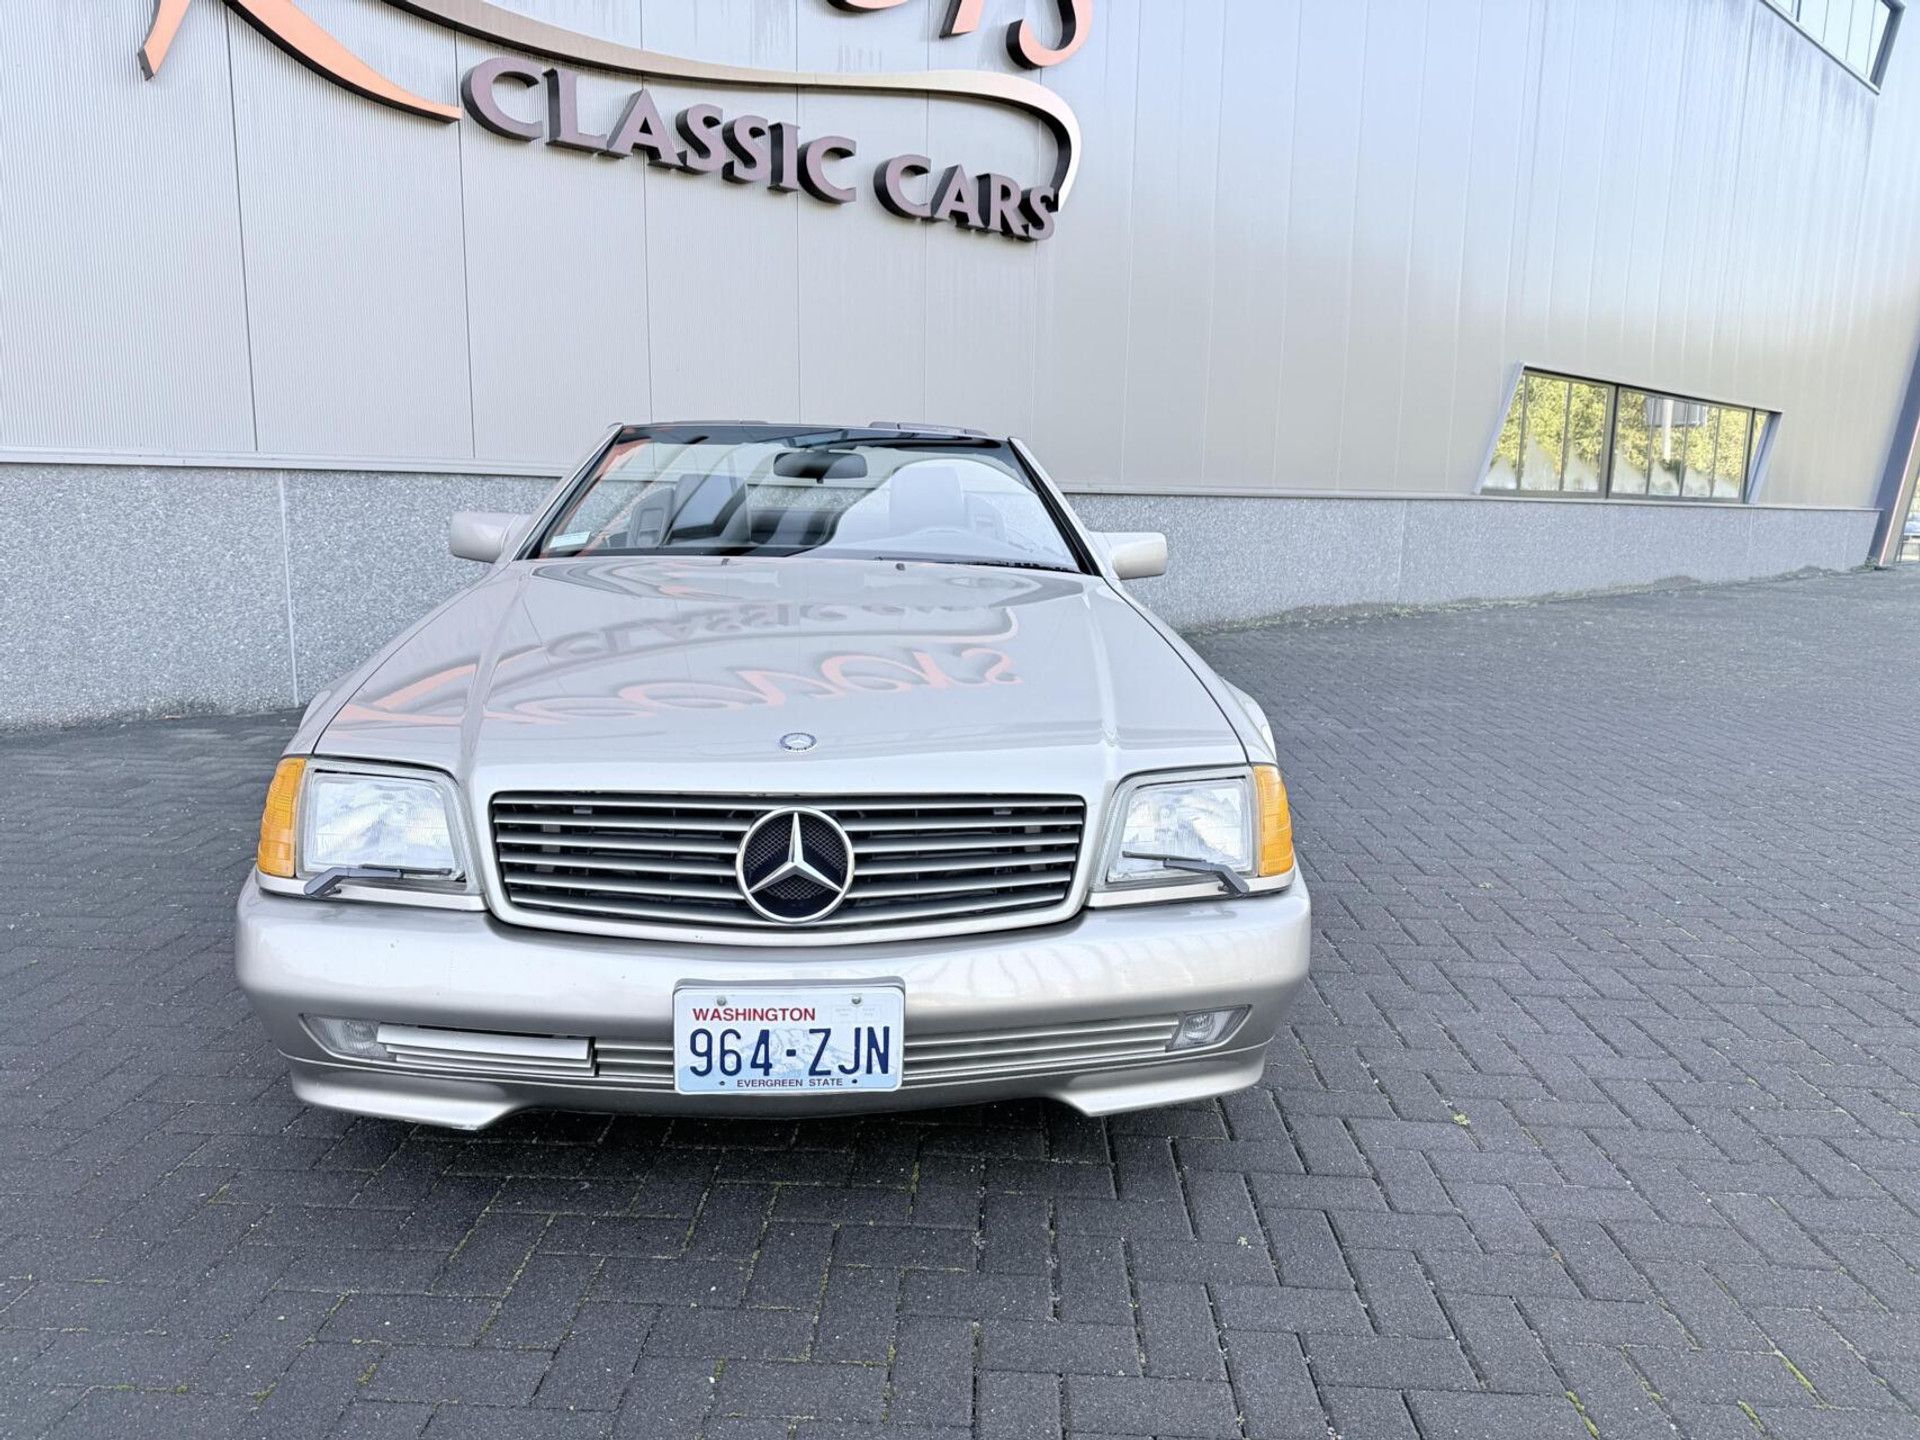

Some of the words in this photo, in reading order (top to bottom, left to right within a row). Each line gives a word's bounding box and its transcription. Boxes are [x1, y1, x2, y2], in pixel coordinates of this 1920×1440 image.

[461, 56, 856, 204] CLASSIC
[873, 154, 1059, 241] CARS
[692, 1007, 816, 1022] WASHINGTON
[689, 1025, 891, 1077] 964-ZJN
[736, 1078, 803, 1088] EVERGREEN
[808, 1077, 843, 1087] STATE
